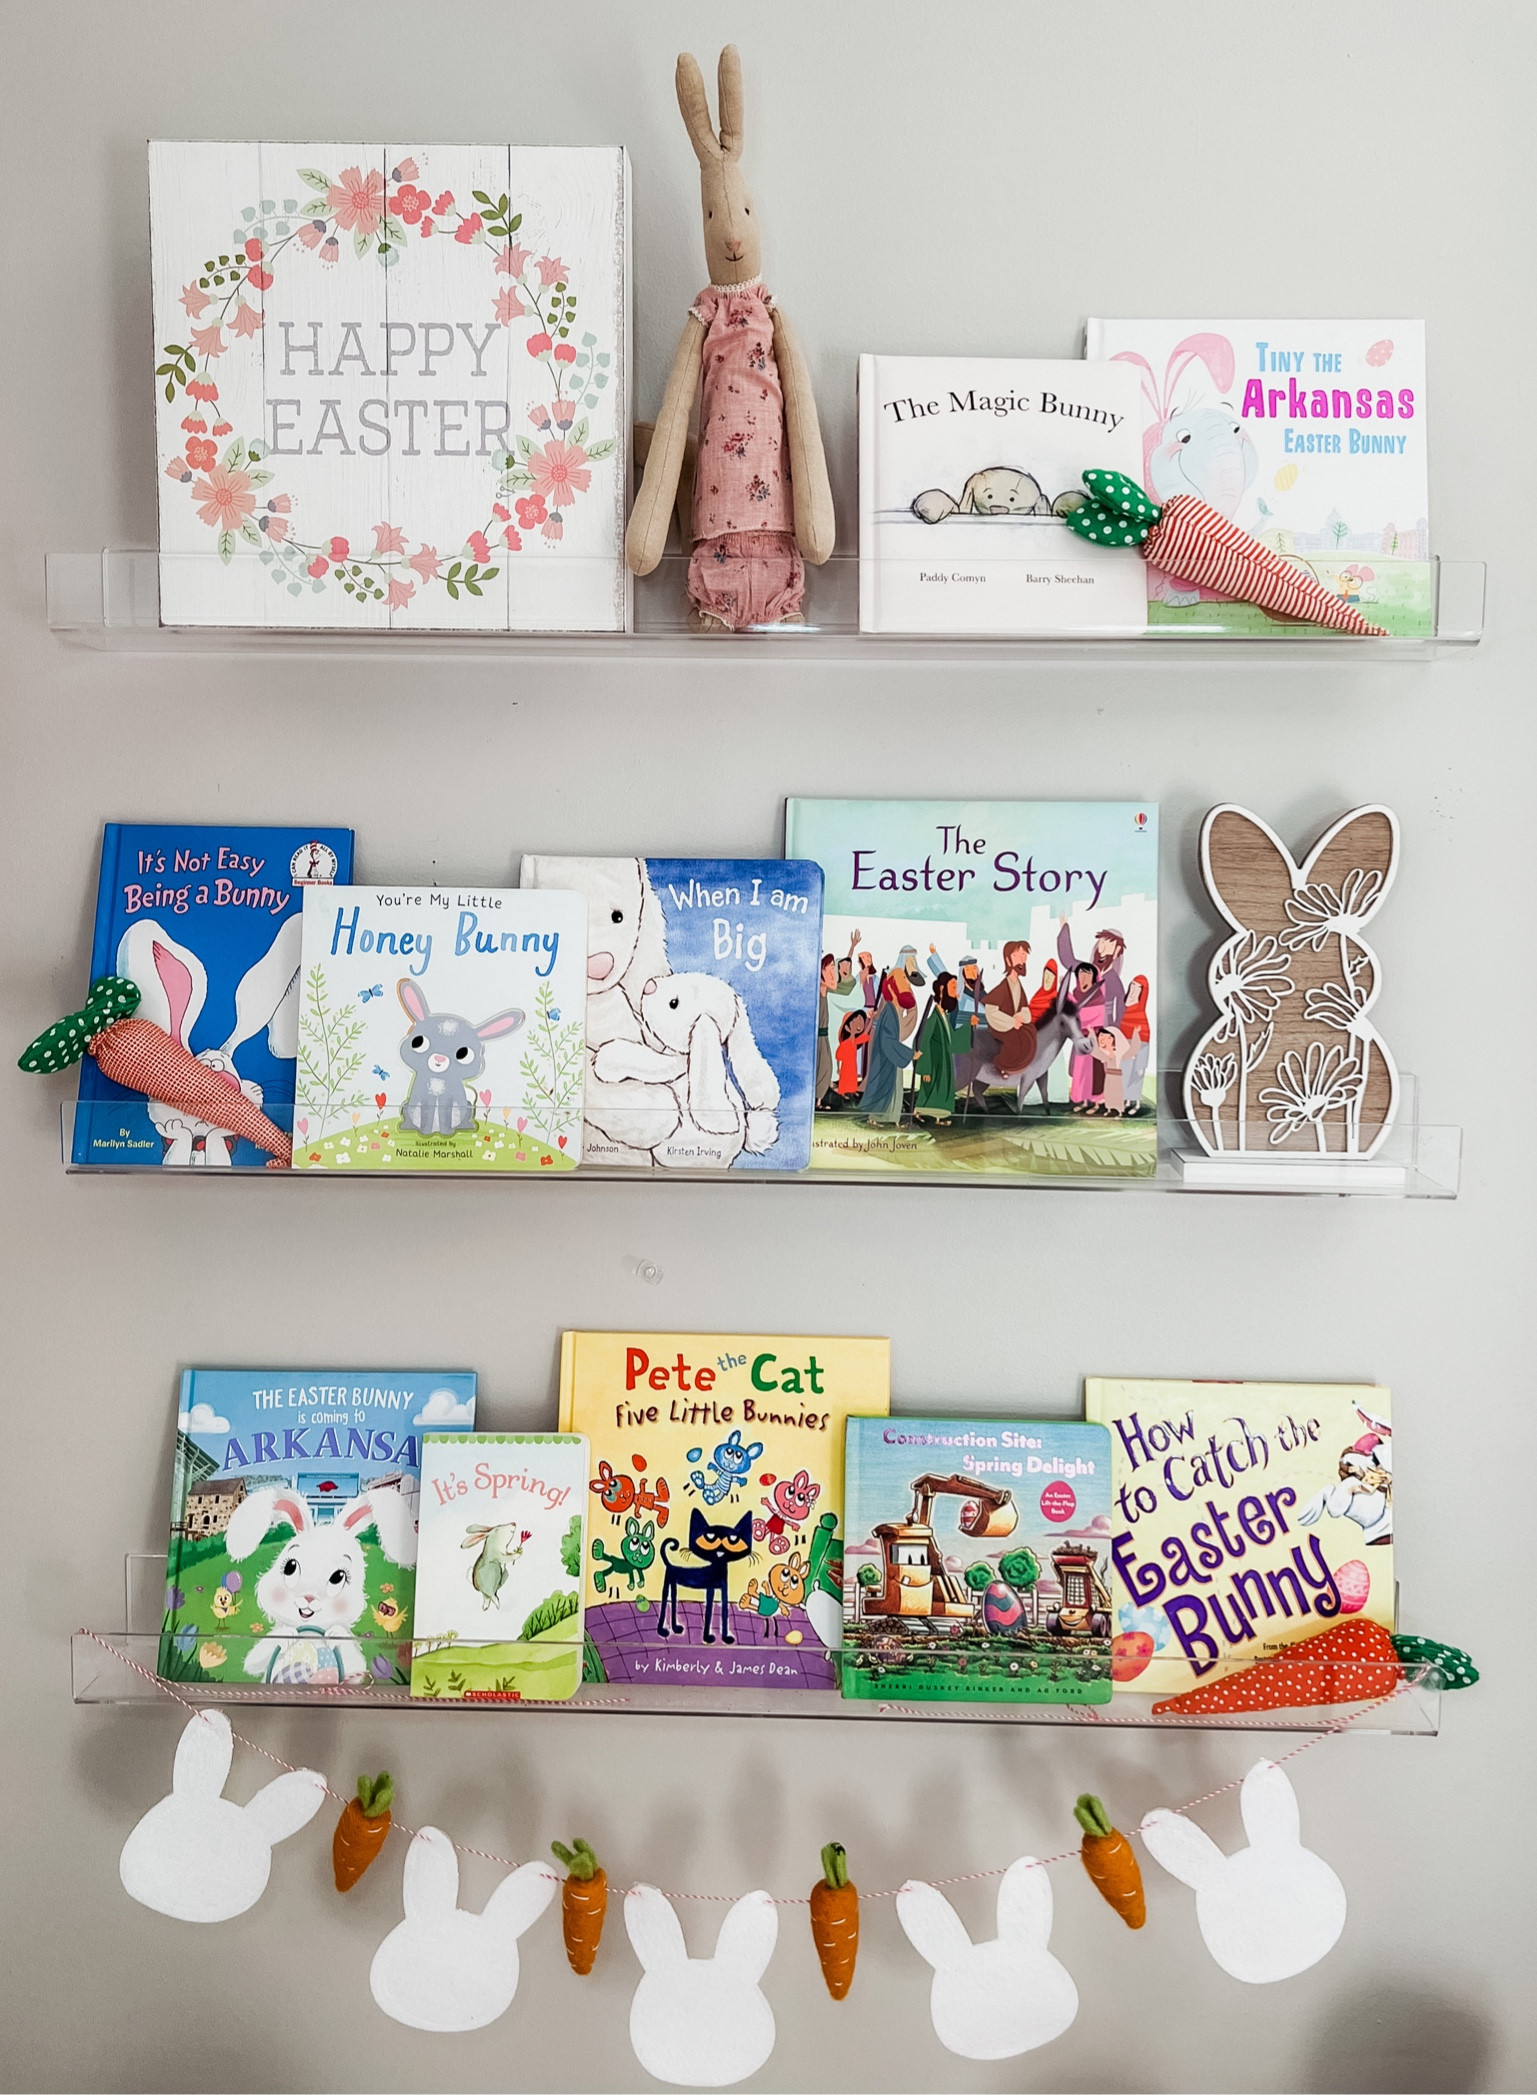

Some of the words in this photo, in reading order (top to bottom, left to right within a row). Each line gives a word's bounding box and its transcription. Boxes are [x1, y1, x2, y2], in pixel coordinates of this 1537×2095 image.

[278, 321, 502, 377] HAPPY
[883, 397, 940, 424] The
[947, 389, 1030, 418] Magic
[1039, 391, 1125, 434] Bunny
[1241, 377, 1415, 419] Arkansas
[266, 398, 515, 457] EASTER
[919, 571, 949, 583] Paddy
[951, 572, 987, 584] Comyn
[1025, 573, 1053, 585] Barry
[1054, 573, 1095, 585] Sheehan
[935, 823, 987, 855] The
[137, 849, 168, 876] It's
[173, 849, 212, 874] Not
[216, 846, 266, 878] Easy
[123, 882, 192, 915] Being
[195, 885, 209, 904] a
[213, 877, 291, 916] Bunny
[668, 878, 741, 911] When
[750, 878, 763, 906] I
[769, 888, 809, 915] am
[851, 850, 976, 892] Easter
[992, 850, 1109, 912] Story
[375, 893, 422, 907] You're
[429, 894, 450, 910] My
[457, 894, 502, 910] Little
[330, 906, 433, 976] Honey
[454, 911, 560, 977] Bunny
[711, 917, 768, 972] Big
[93, 1139, 125, 1150] Marilyn
[127, 1139, 154, 1148] Sadler
[119, 1128, 130, 1138] By
[586, 1143, 619, 1154] Johnson
[852, 1137, 864, 1152] by
[864, 1137, 889, 1152] John
[889, 1136, 918, 1153] Joven
[395, 1148, 430, 1158] Natalie
[433, 1150, 474, 1158] Marshall
[696, 1146, 722, 1160] Irving
[624, 1347, 716, 1392] Pete
[716, 1352, 748, 1373] the
[750, 1352, 825, 1395] Cat
[252, 1388, 284, 1411] THE
[288, 1385, 348, 1408] EASTER
[351, 1386, 415, 1411] BUNNY
[615, 1401, 658, 1430] Five
[669, 1397, 733, 1425] Little
[743, 1398, 831, 1431] Bunnies
[298, 1410, 306, 1425] is
[311, 1409, 349, 1426] coming
[354, 1408, 366, 1424] to
[221, 1427, 420, 1472] ARKANSA
[882, 1428, 998, 1449] Construction
[1000, 1431, 1043, 1450] Site:
[1111, 1409, 1195, 1473] How
[962, 1454, 1023, 1477] Spring
[1026, 1456, 1096, 1479] Delight
[1114, 1483, 1158, 1524] to
[1162, 1416, 1269, 1501] Catch
[1274, 1413, 1321, 1452] the
[431, 1472, 469, 1506] It's
[474, 1462, 572, 1511] Spring!
[1111, 1486, 1297, 1609] Easter
[1162, 1533, 1343, 1679] Bunny
[1262, 1642, 1278, 1651] From
[634, 1660, 649, 1675] by
[655, 1658, 711, 1677] Kimberly
[714, 1661, 725, 1676] &
[729, 1661, 765, 1676] James
[768, 1661, 798, 1676] Dean
